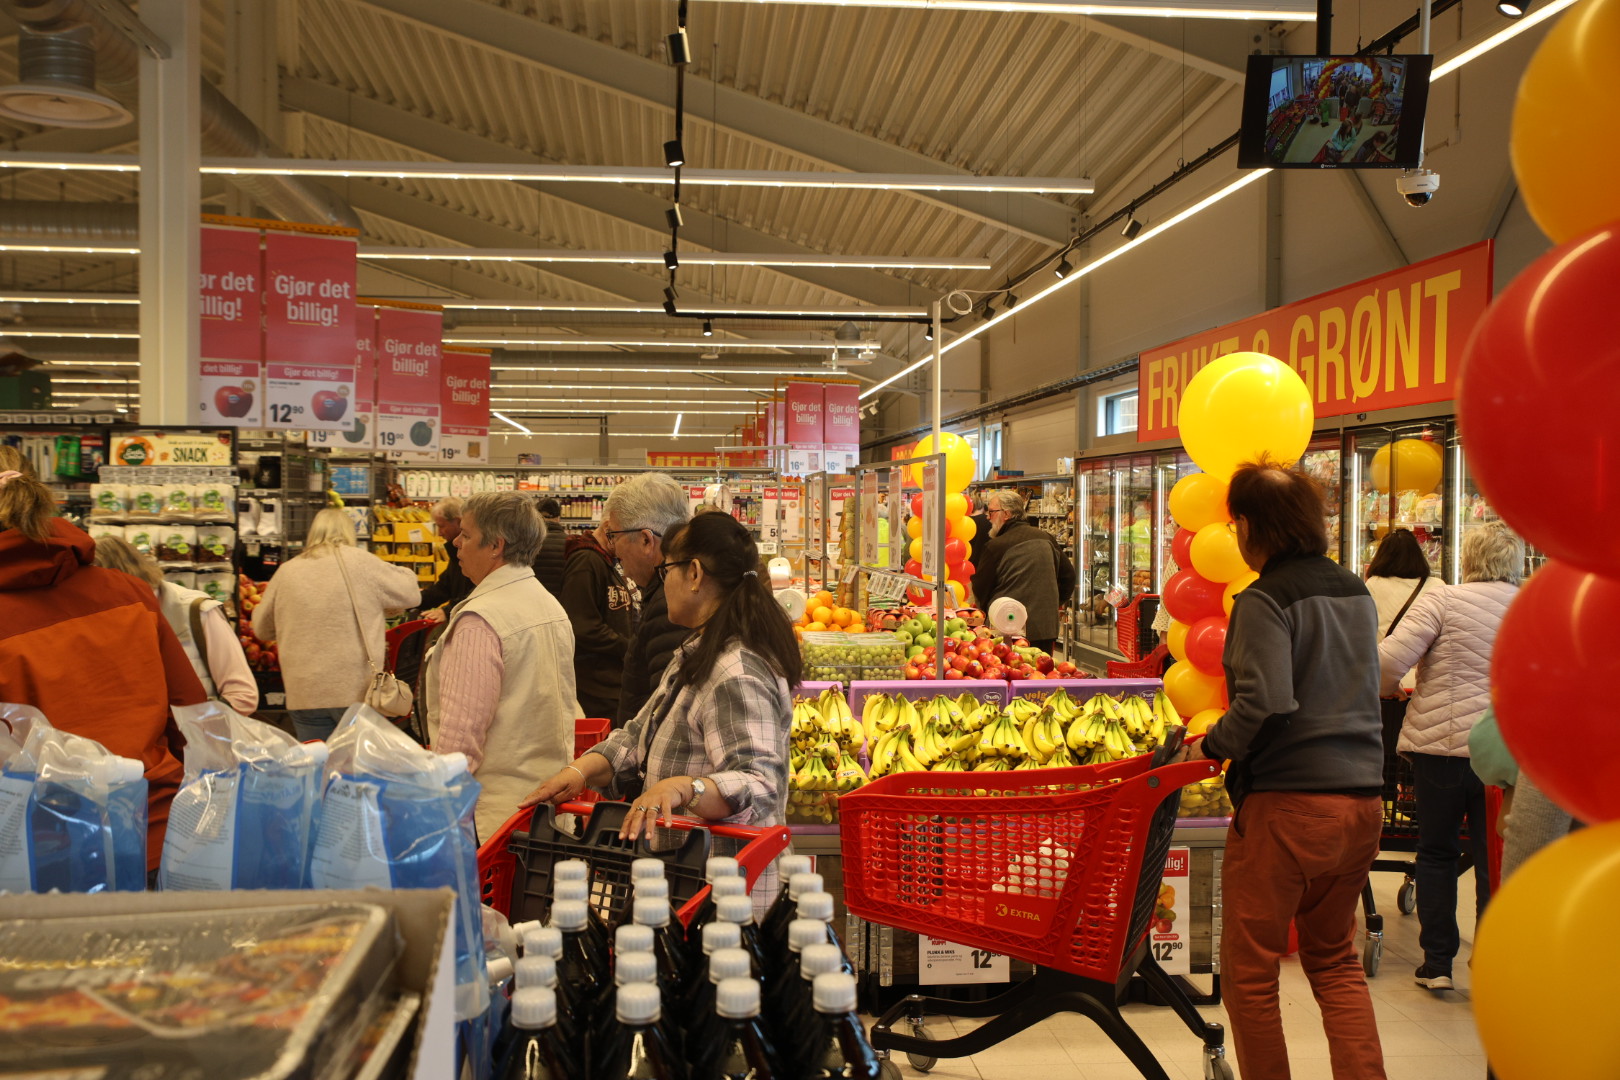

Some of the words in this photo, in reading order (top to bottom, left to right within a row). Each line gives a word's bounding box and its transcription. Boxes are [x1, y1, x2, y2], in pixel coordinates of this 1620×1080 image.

[200, 274, 216, 289] ør
[221, 272, 254, 292] det
[274, 275, 315, 299] Gjør
[319, 279, 350, 299] det
[200, 295, 242, 321] illig!
[287, 301, 338, 327] billig!
[1289, 269, 1461, 404] GRØNT
[385, 339, 413, 356] Gjør
[415, 342, 437, 356] det
[219, 365, 243, 375] billig!
[284, 368, 301, 377] Gjør
[302, 370, 315, 378] det
[316, 371, 339, 379] billig!
[392, 358, 428, 376] billig!
[446, 376, 468, 389] Gjør
[470, 378, 486, 389] det
[452, 391, 479, 405] billig!
[791, 401, 807, 413] Gjør
[808, 402, 821, 412] det
[828, 403, 844, 415] Gjør
[845, 405, 857, 413] det
[796, 413, 817, 425] billig!
[832, 415, 853, 426] billig!
[173, 447, 208, 462] SNACK
[765, 490, 776, 498] Gjør
[832, 490, 843, 498] Gjør
[1164, 857, 1184, 871] llig!
[1010, 908, 1041, 922] EXTRA
